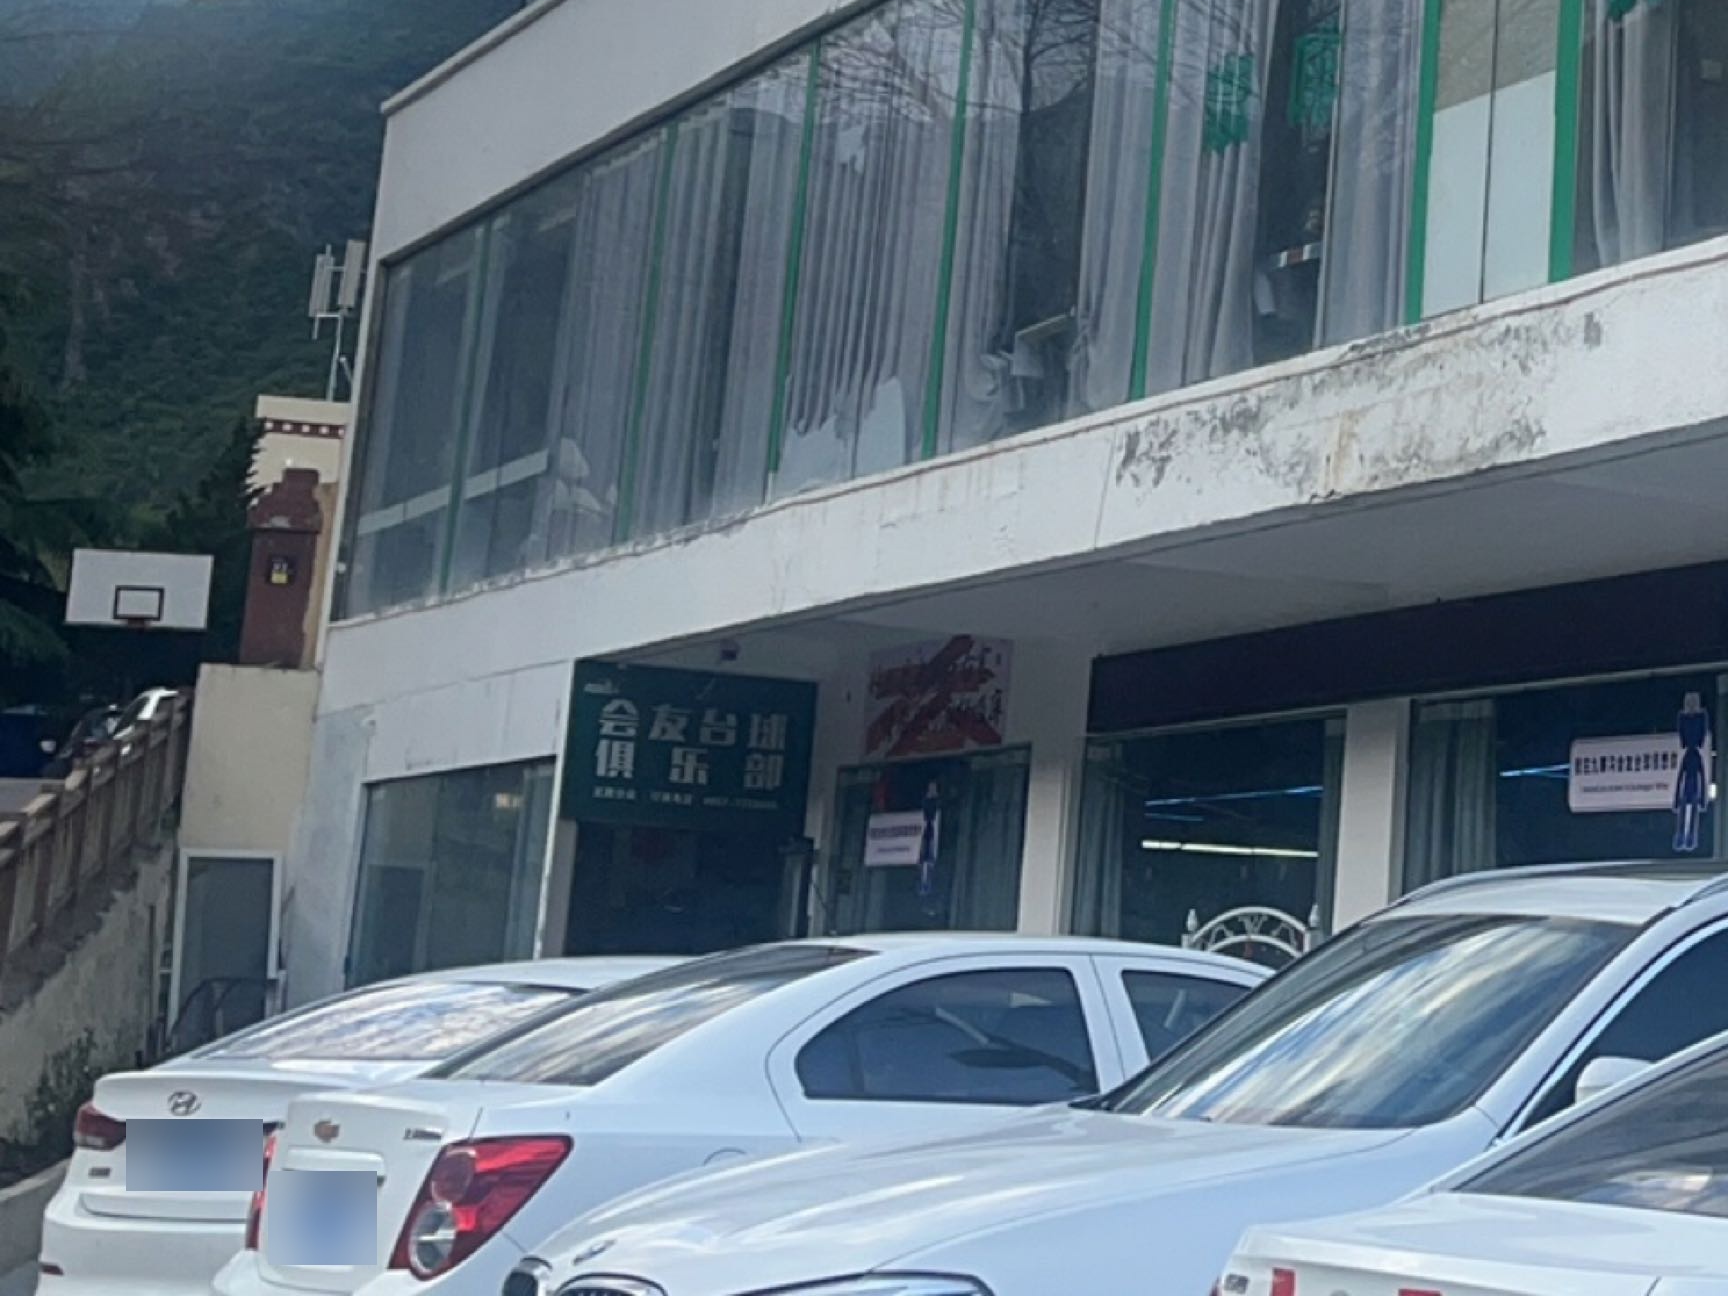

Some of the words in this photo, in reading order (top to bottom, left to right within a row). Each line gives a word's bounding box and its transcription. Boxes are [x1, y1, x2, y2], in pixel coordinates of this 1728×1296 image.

[598, 698, 788, 751] 会友台球
[596, 739, 784, 790] 俱乐部
